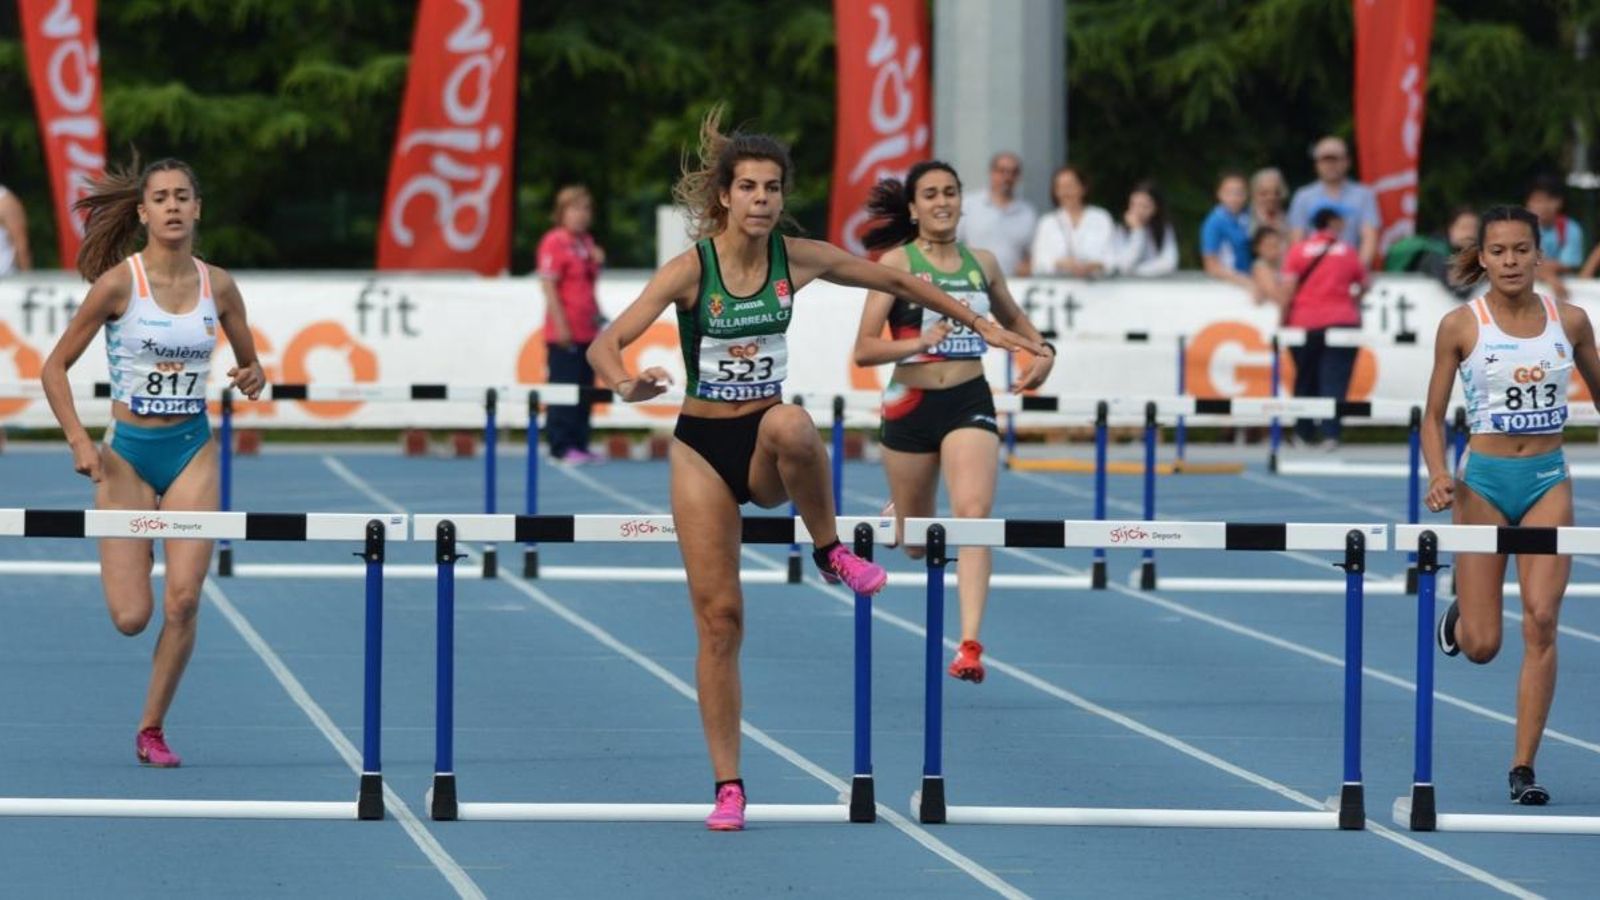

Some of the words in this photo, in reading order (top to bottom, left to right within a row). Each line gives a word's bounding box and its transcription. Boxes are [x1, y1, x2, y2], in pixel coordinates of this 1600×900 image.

[356, 280, 420, 338] fit
[708, 313, 775, 328] VILLARREAL
[728, 342, 759, 359] GO
[717, 356, 774, 382] 523
[1513, 366, 1546, 384] GO
[146, 371, 199, 396] 817
[1504, 383, 1558, 411] 813
[129, 516, 168, 534] gijón
[172, 522, 203, 531] Deporte
[620, 519, 660, 537] gijón
[1109, 525, 1149, 543] gijón
[1152, 531, 1182, 540] Deporte
